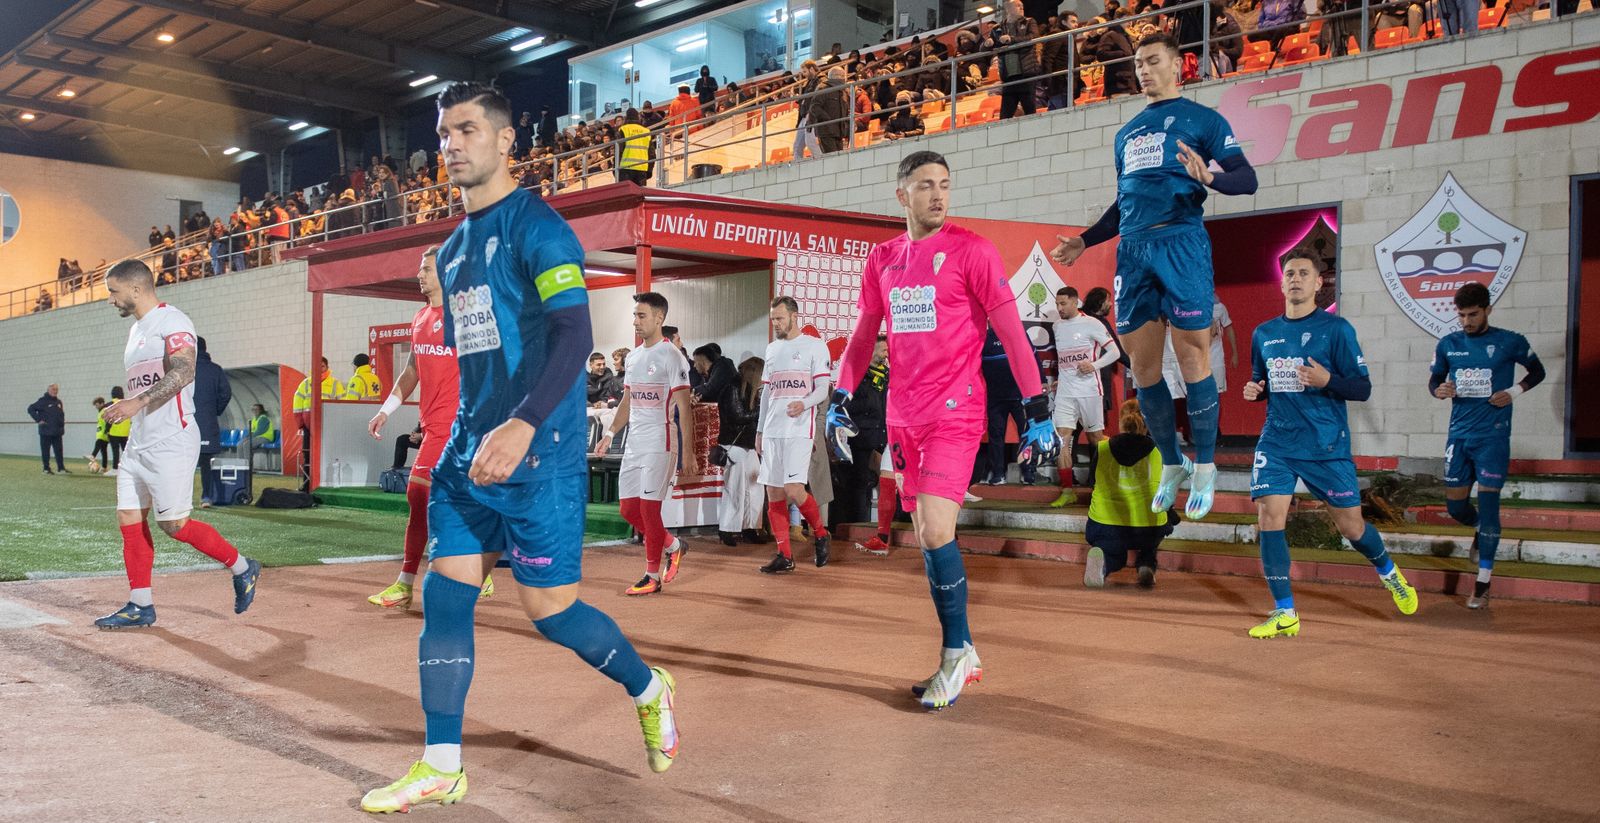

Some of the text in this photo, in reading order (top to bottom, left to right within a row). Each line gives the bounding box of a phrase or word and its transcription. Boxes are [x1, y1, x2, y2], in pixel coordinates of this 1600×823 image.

[651, 213, 708, 238] UNIÓN
[713, 221, 801, 249] DEPORTIVA
[807, 234, 838, 254] SAN
[555, 269, 574, 284] C
[1385, 272, 1399, 291] SAN
[1396, 292, 1443, 334] SEBASTIAN
[379, 329, 392, 338] SAN
[486, 327, 497, 336] DE
